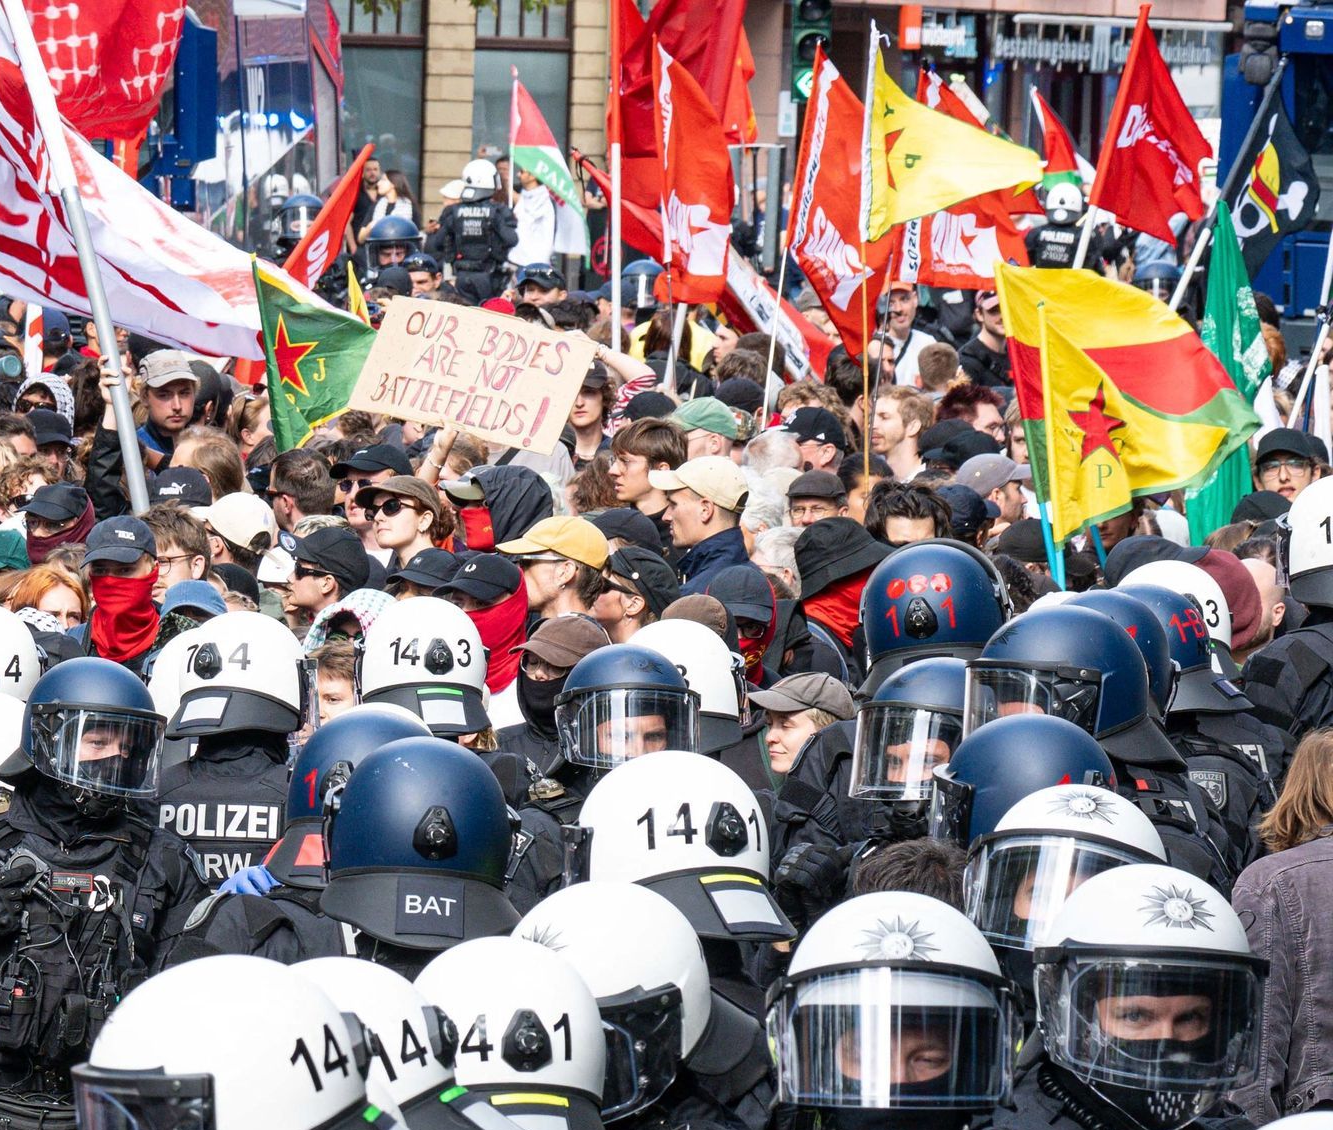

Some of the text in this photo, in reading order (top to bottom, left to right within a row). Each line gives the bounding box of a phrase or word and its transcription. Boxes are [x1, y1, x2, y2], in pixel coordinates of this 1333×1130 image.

[405, 310, 570, 375] OUR BODIES
[313, 357, 327, 383] J
[413, 343, 524, 392] ARE NOT
[1093, 463, 1113, 488] P
[885, 595, 957, 638] 1 1
[1207, 599, 1222, 628] 3
[4, 654, 23, 683] 4
[228, 642, 251, 671] 4
[389, 637, 472, 668] 14 3
[304, 768, 319, 809] 1
[158, 803, 280, 840] POLIZEI
[748, 808, 762, 852] 1
[405, 894, 457, 917] BAT
[370, 1019, 429, 1083] 14
[552, 1012, 572, 1061] 1
[289, 1023, 350, 1093] 14
